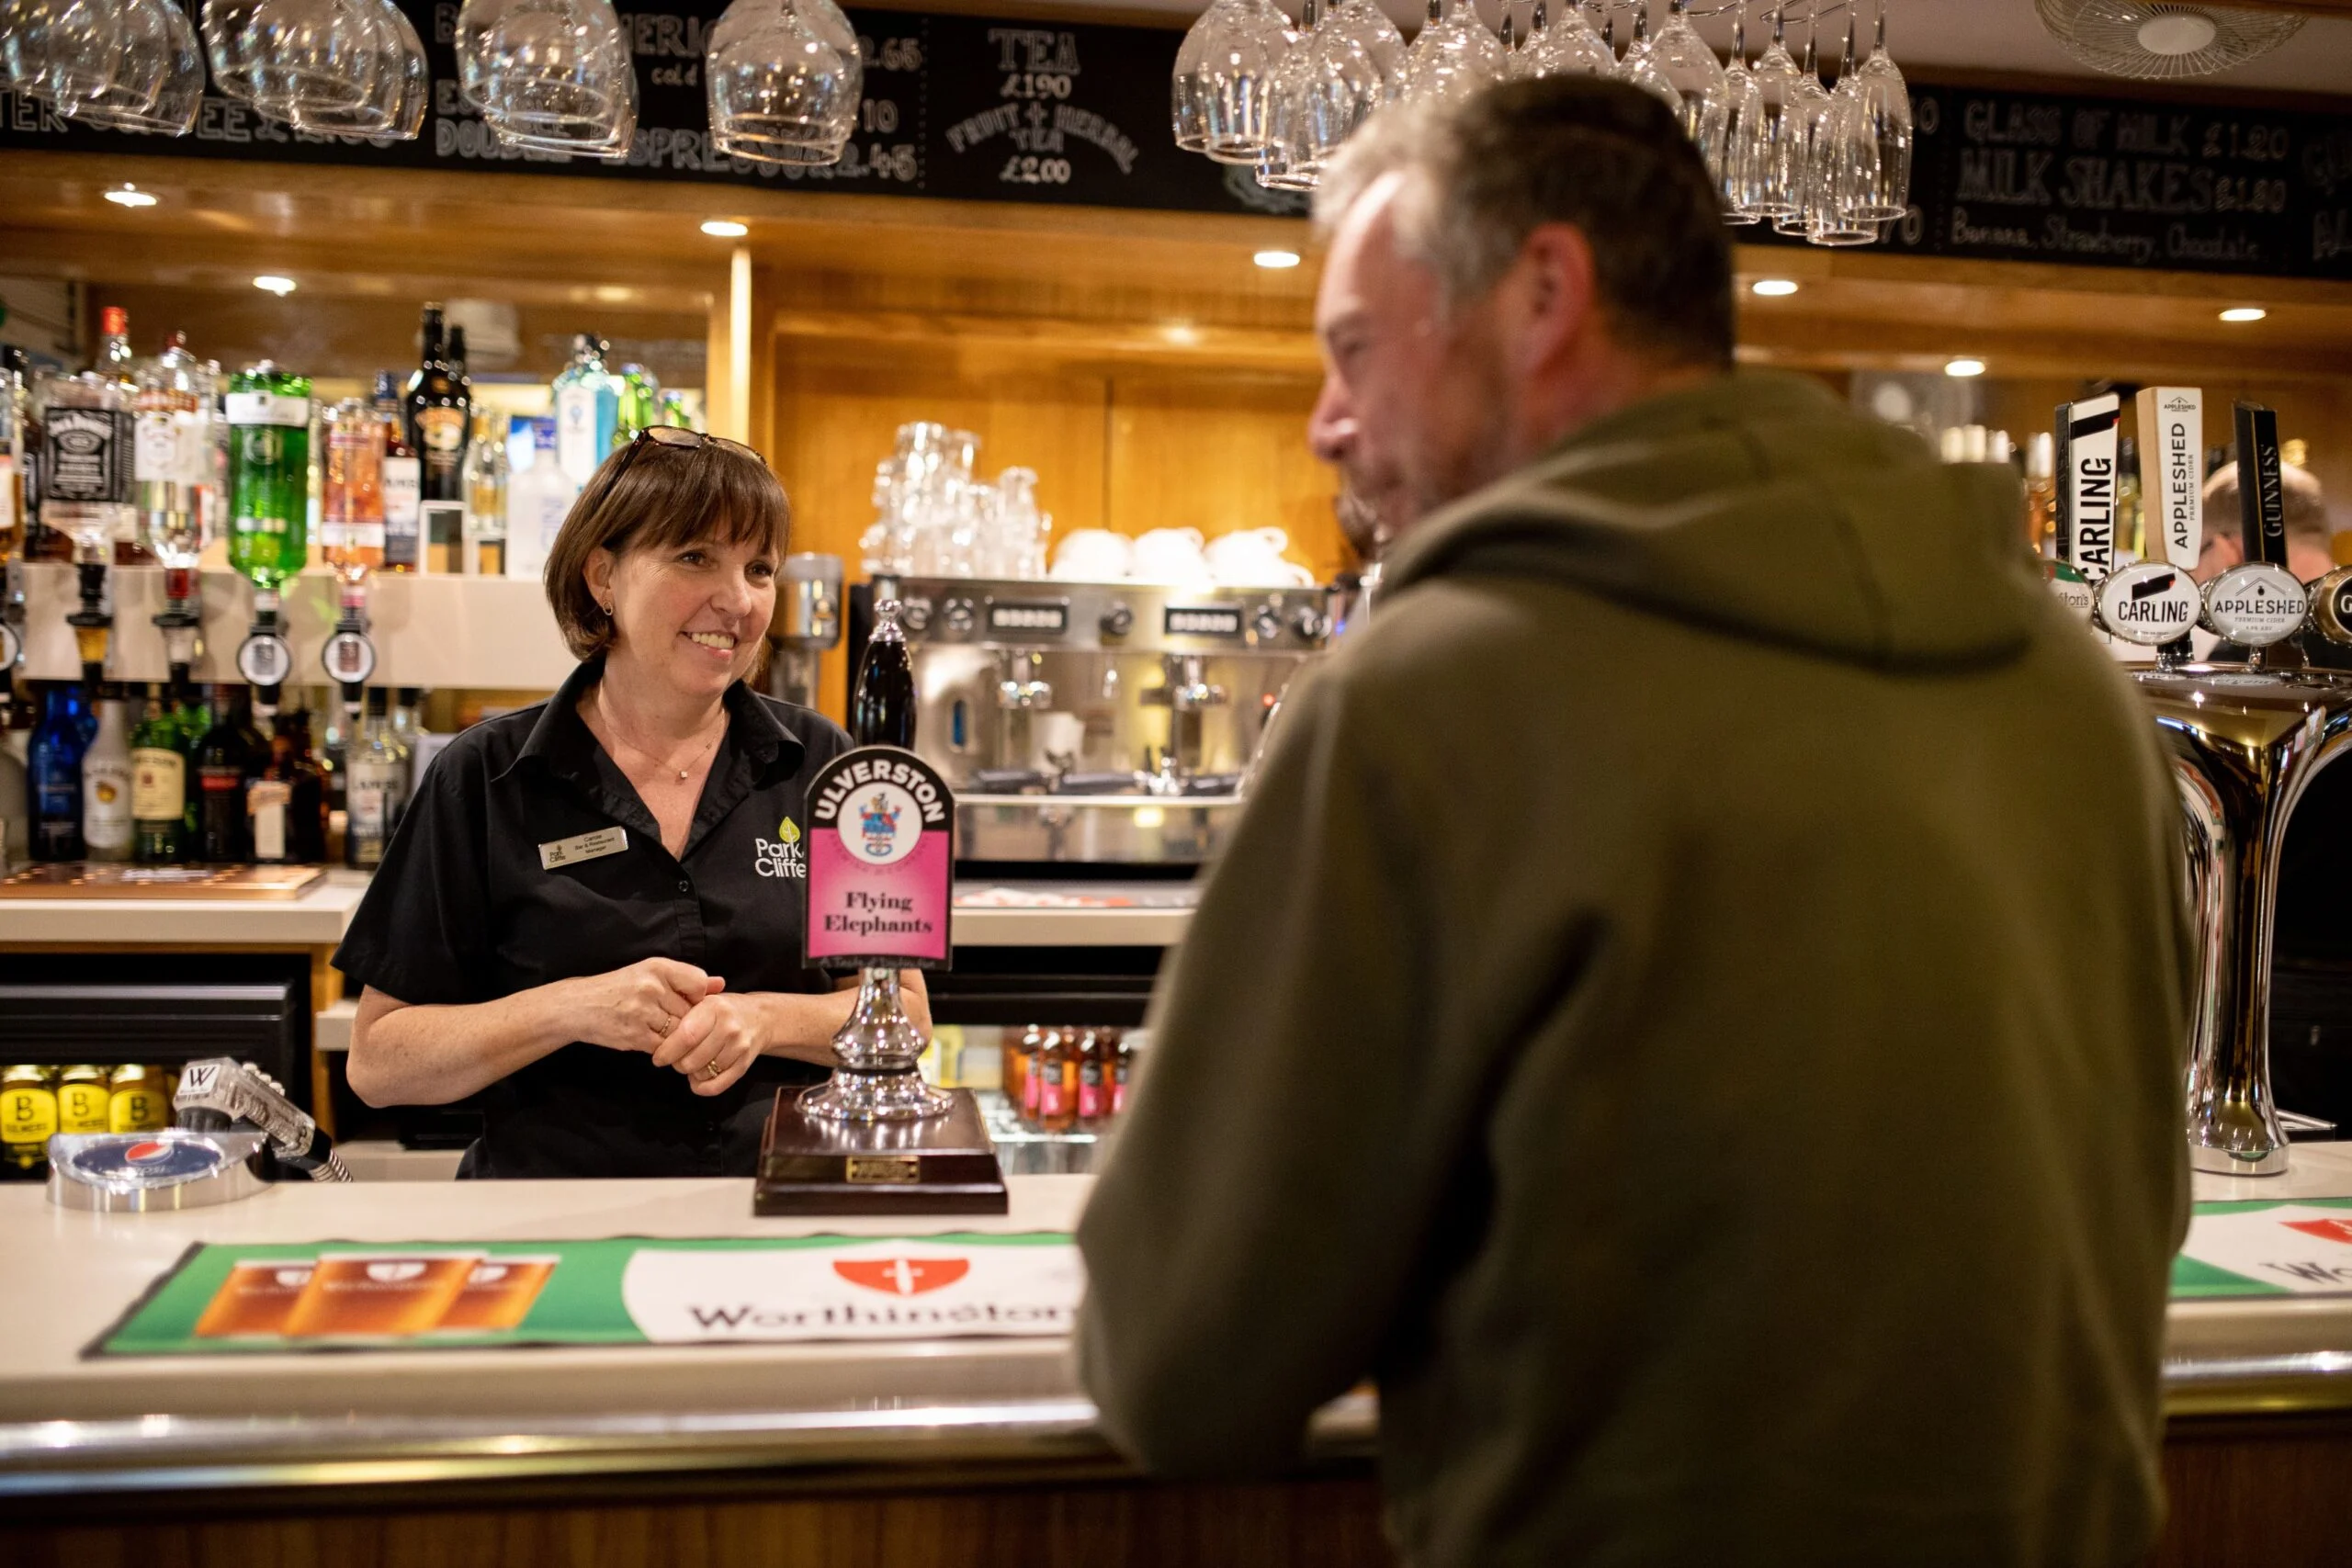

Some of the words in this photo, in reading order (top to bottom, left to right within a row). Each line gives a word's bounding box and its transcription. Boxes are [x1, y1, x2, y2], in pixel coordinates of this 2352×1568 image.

[987, 28, 1082, 76] TEA
[650, 62, 699, 87] cold
[944, 101, 1021, 154] FRUIT
[1053, 103, 1140, 175] HERBAL
[1008, 127, 1065, 154] TEA
[1963, 97, 2064, 147] GLASS
[2072, 107, 2112, 152] OF
[2115, 110, 2192, 157] MILK
[1955, 146, 2055, 207] MILK
[2059, 154, 2216, 216] SHAKES
[2171, 423, 2188, 549] APPLESHED
[2263, 446, 2283, 537] GUINNESS
[2188, 482, 2196, 521] PREMIUM
[2079, 457, 2112, 581] CARLING
[2118, 600, 2188, 623] CARLING
[2213, 599, 2305, 615] APPLESHED
[814, 759, 945, 823] ULVERSTON
[755, 838, 804, 858] Park
[754, 857, 806, 878] Cliffe
[845, 891, 913, 913] Flying
[824, 914, 933, 937] Elephants
[188, 1066, 217, 1088] W
[15, 1096, 34, 1122] B
[72, 1091, 90, 1118] B
[130, 1096, 149, 1122] B
